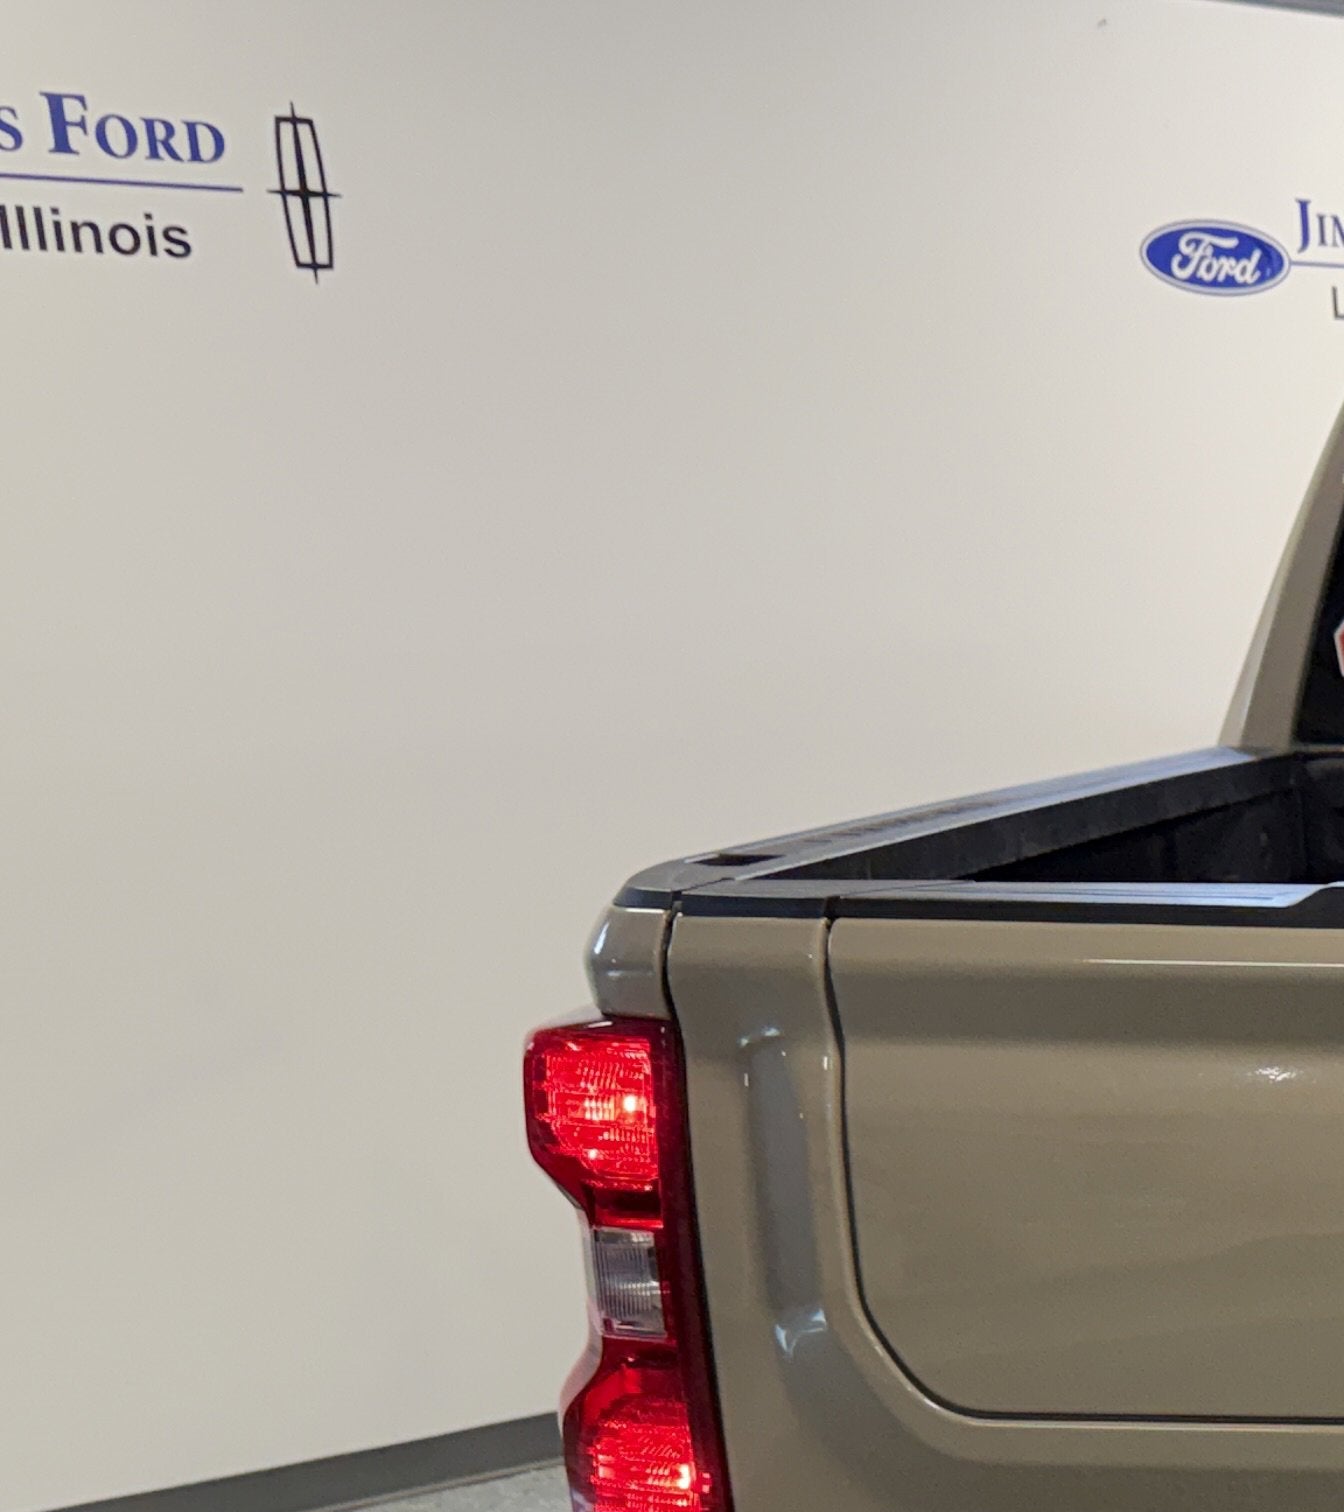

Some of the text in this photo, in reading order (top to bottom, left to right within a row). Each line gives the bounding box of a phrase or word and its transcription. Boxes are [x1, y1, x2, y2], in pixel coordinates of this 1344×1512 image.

[39, 91, 225, 163] FORD
[0, 204, 192, 258] Illinois
[1171, 231, 1261, 284] Ford
